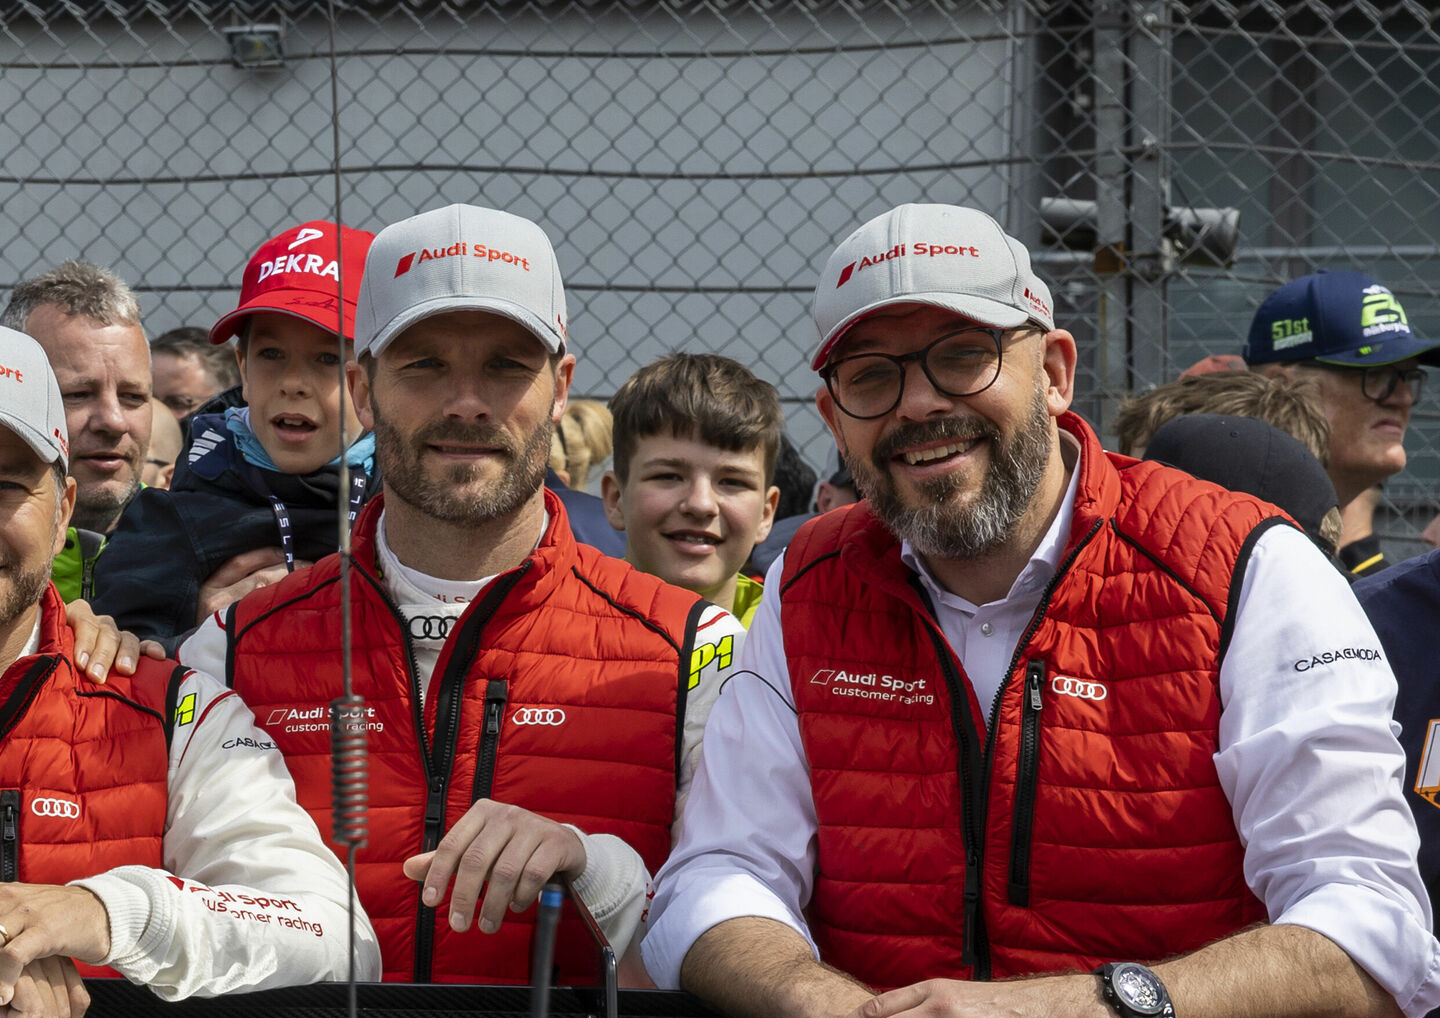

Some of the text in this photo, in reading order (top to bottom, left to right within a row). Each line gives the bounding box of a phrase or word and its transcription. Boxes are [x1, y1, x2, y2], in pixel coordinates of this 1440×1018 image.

[257, 253, 340, 283] DEKRA
[418, 242, 530, 272] Audi Sport
[858, 242, 980, 272] Audi Sport
[1272, 317, 1310, 340] 51st
[687, 634, 735, 692] P1
[834, 670, 926, 692] Audi Sport
[832, 686, 897, 701] customer
[287, 707, 324, 720] Audi
[237, 894, 302, 912] Sport
[277, 915, 324, 937] racing
